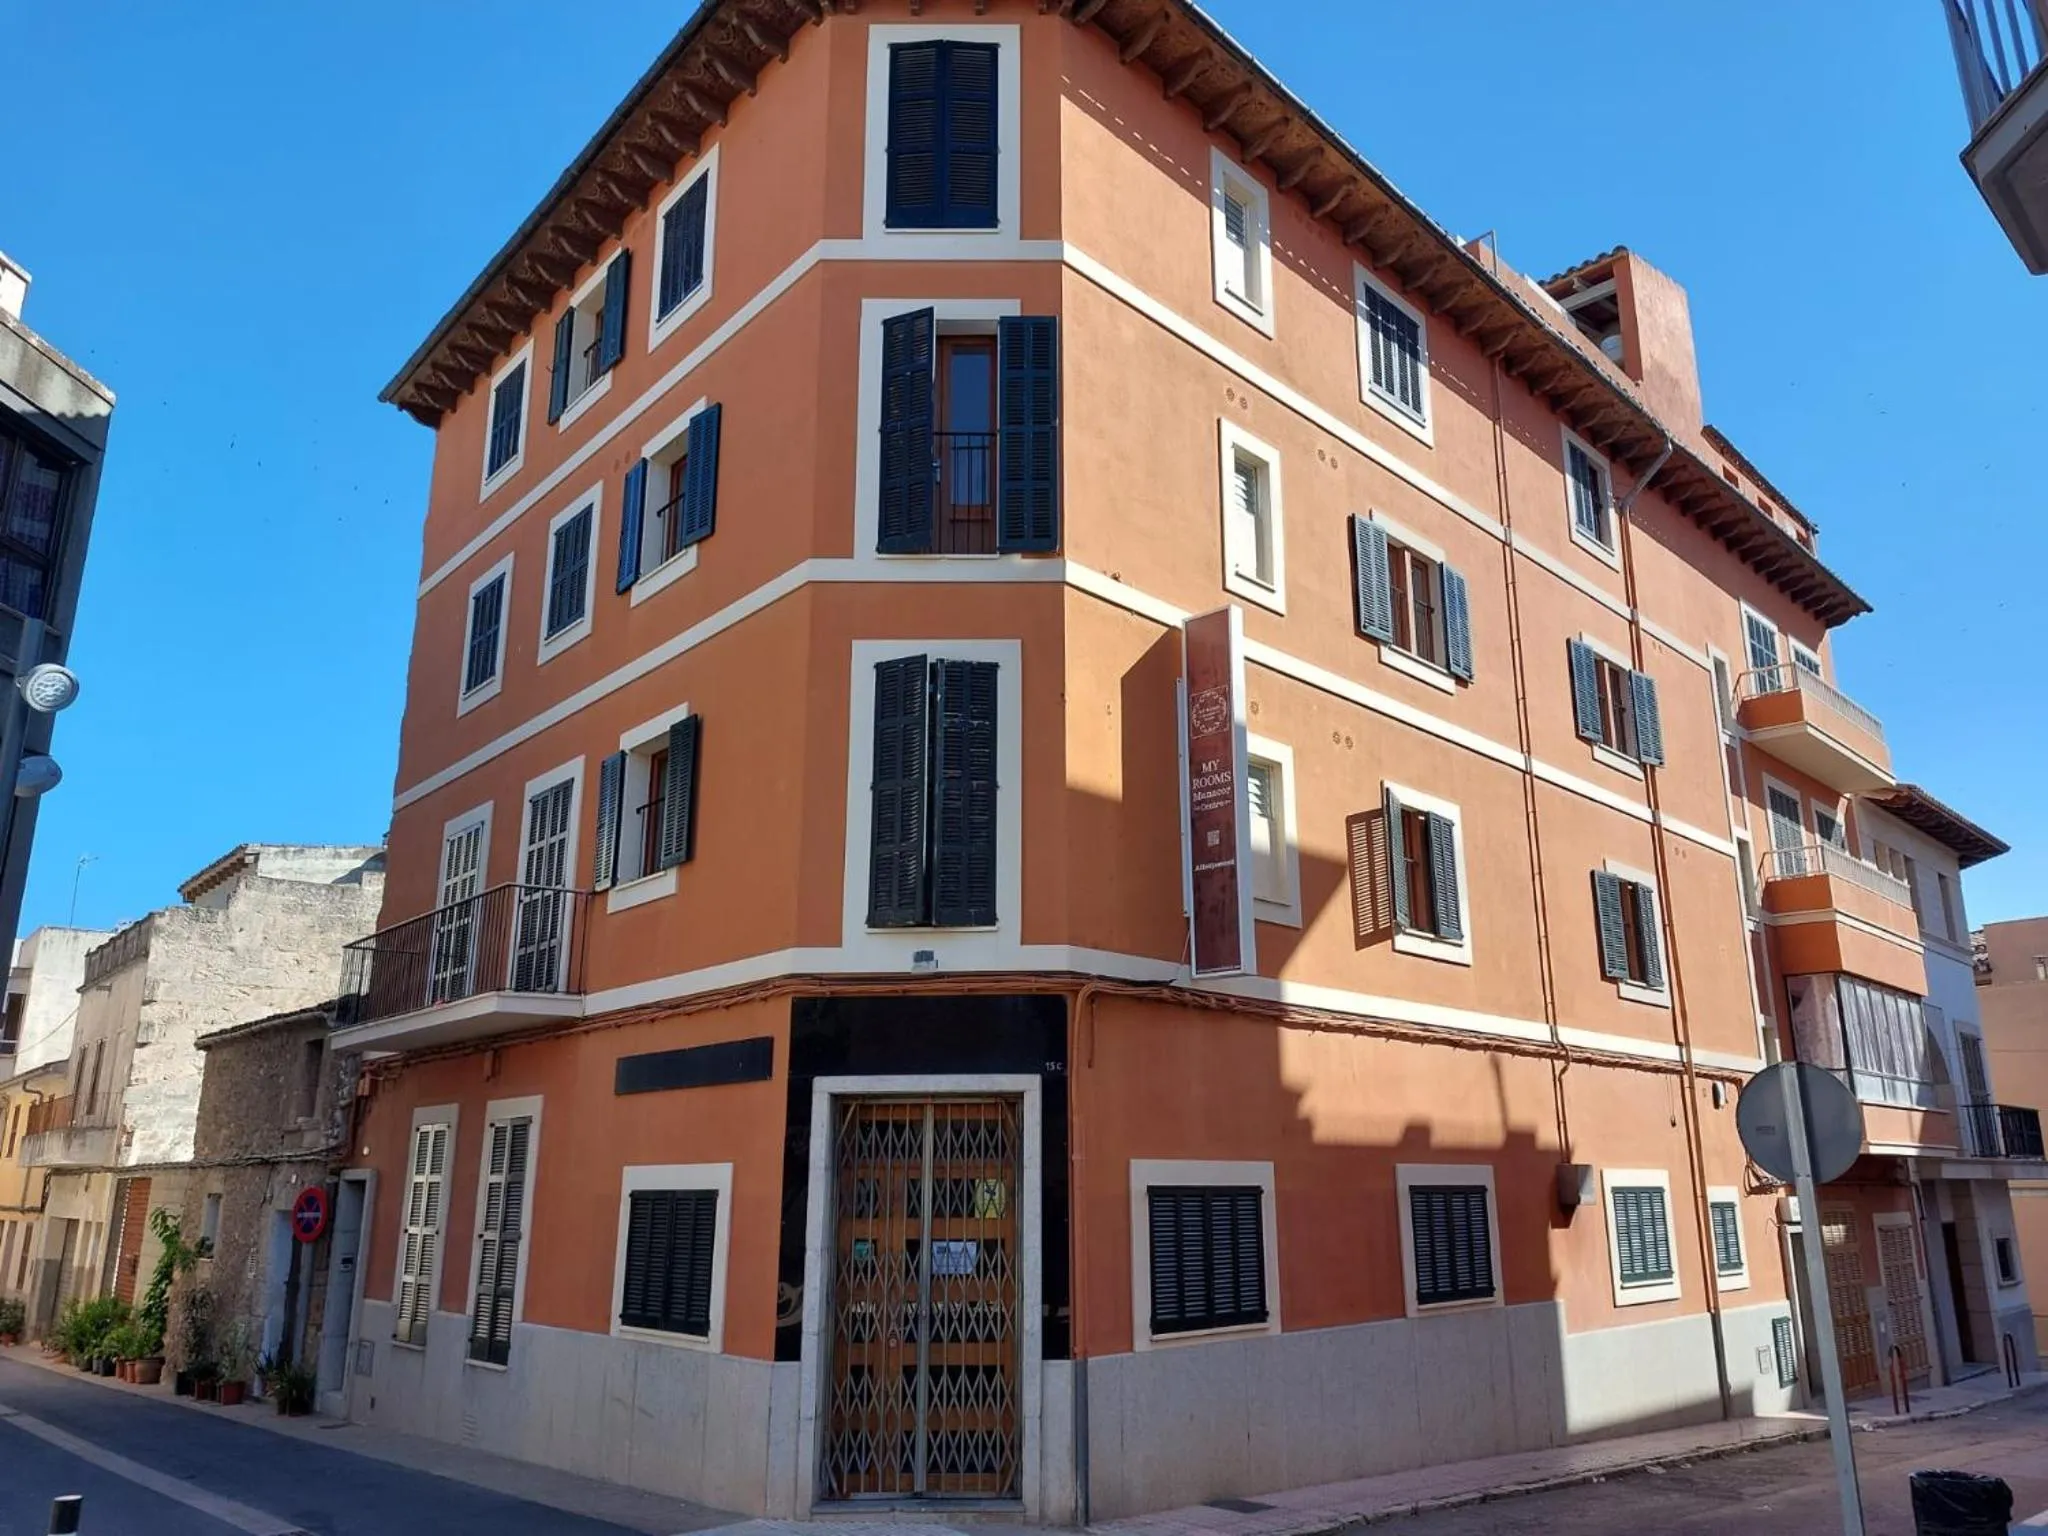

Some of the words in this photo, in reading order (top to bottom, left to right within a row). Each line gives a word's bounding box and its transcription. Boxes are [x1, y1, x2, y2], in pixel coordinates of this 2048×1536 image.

[1202, 759, 1220, 772] MY
[1192, 772, 1231, 789] ROOMS
[1193, 787, 1231, 801] Manacor
